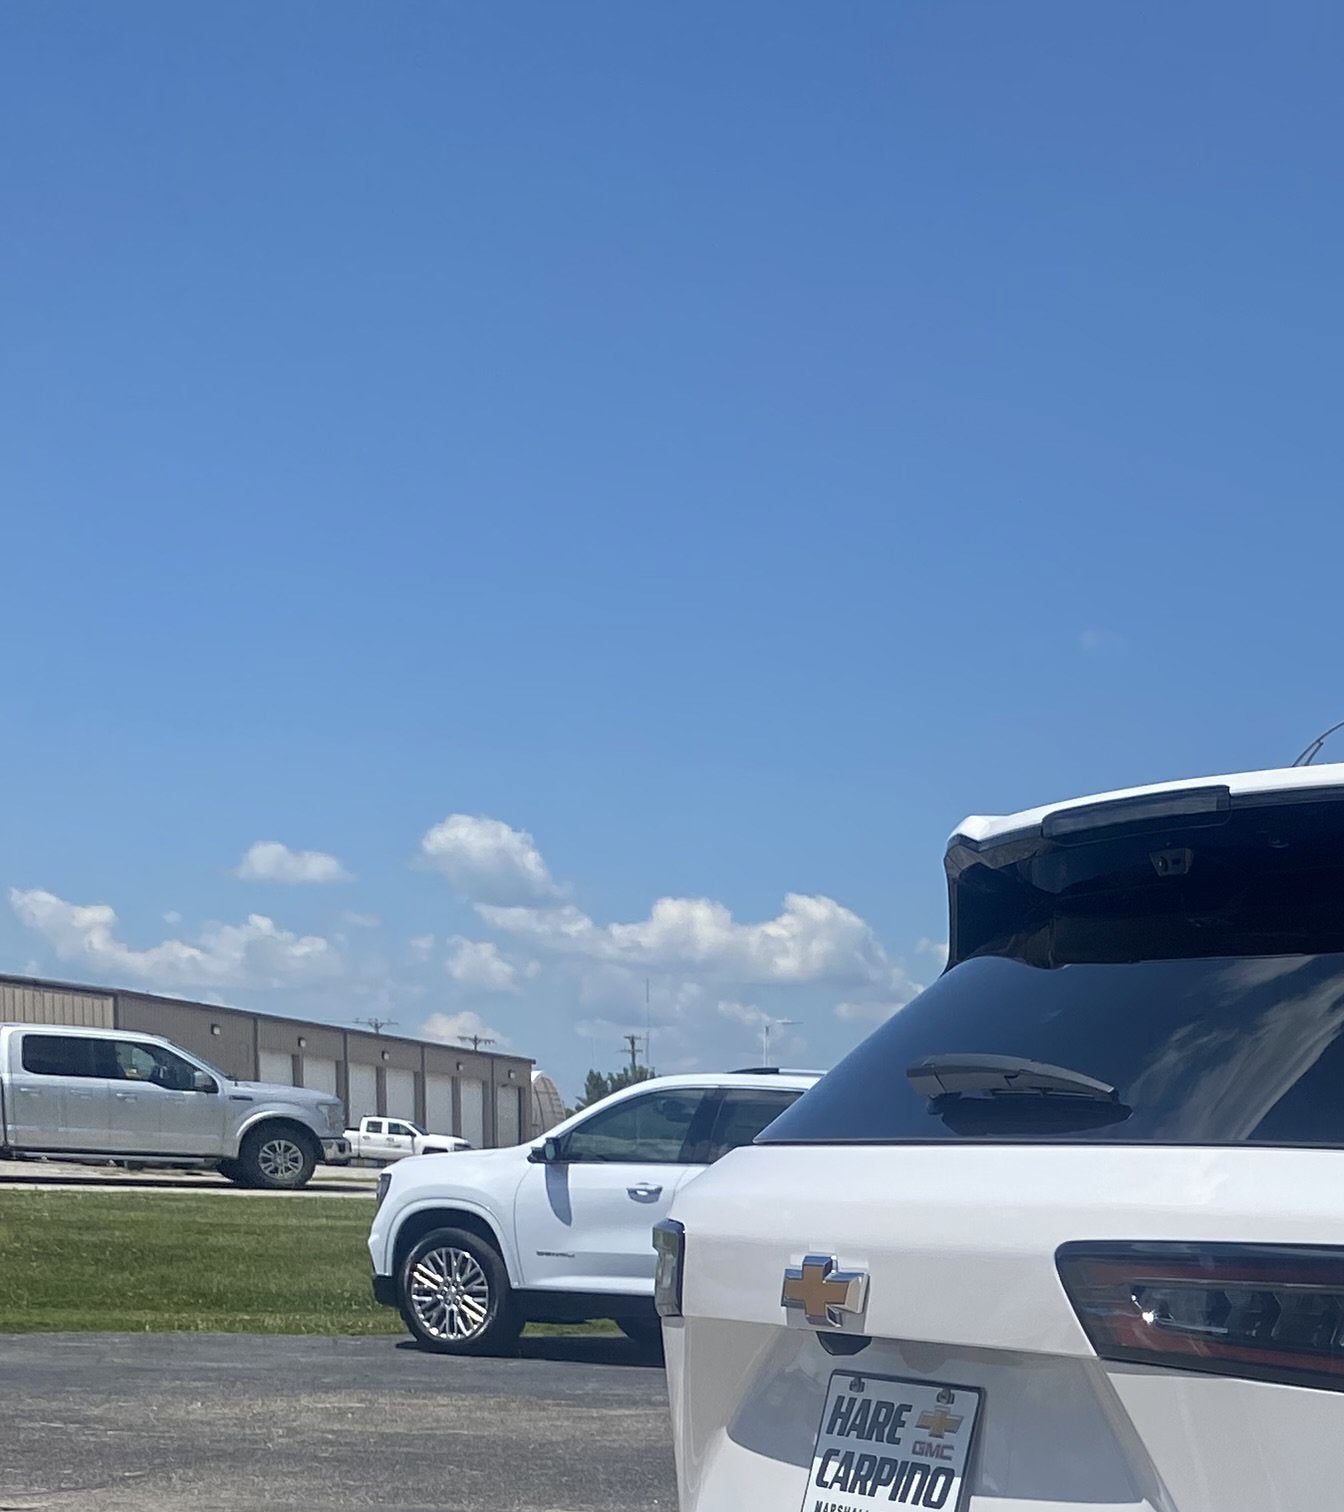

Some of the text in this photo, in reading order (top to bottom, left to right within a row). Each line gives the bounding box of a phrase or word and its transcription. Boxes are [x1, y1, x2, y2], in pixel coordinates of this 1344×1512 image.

[826, 1395, 912, 1445] HARE
[912, 1441, 955, 1461] GMC
[815, 1448, 955, 1509] CARPINO
